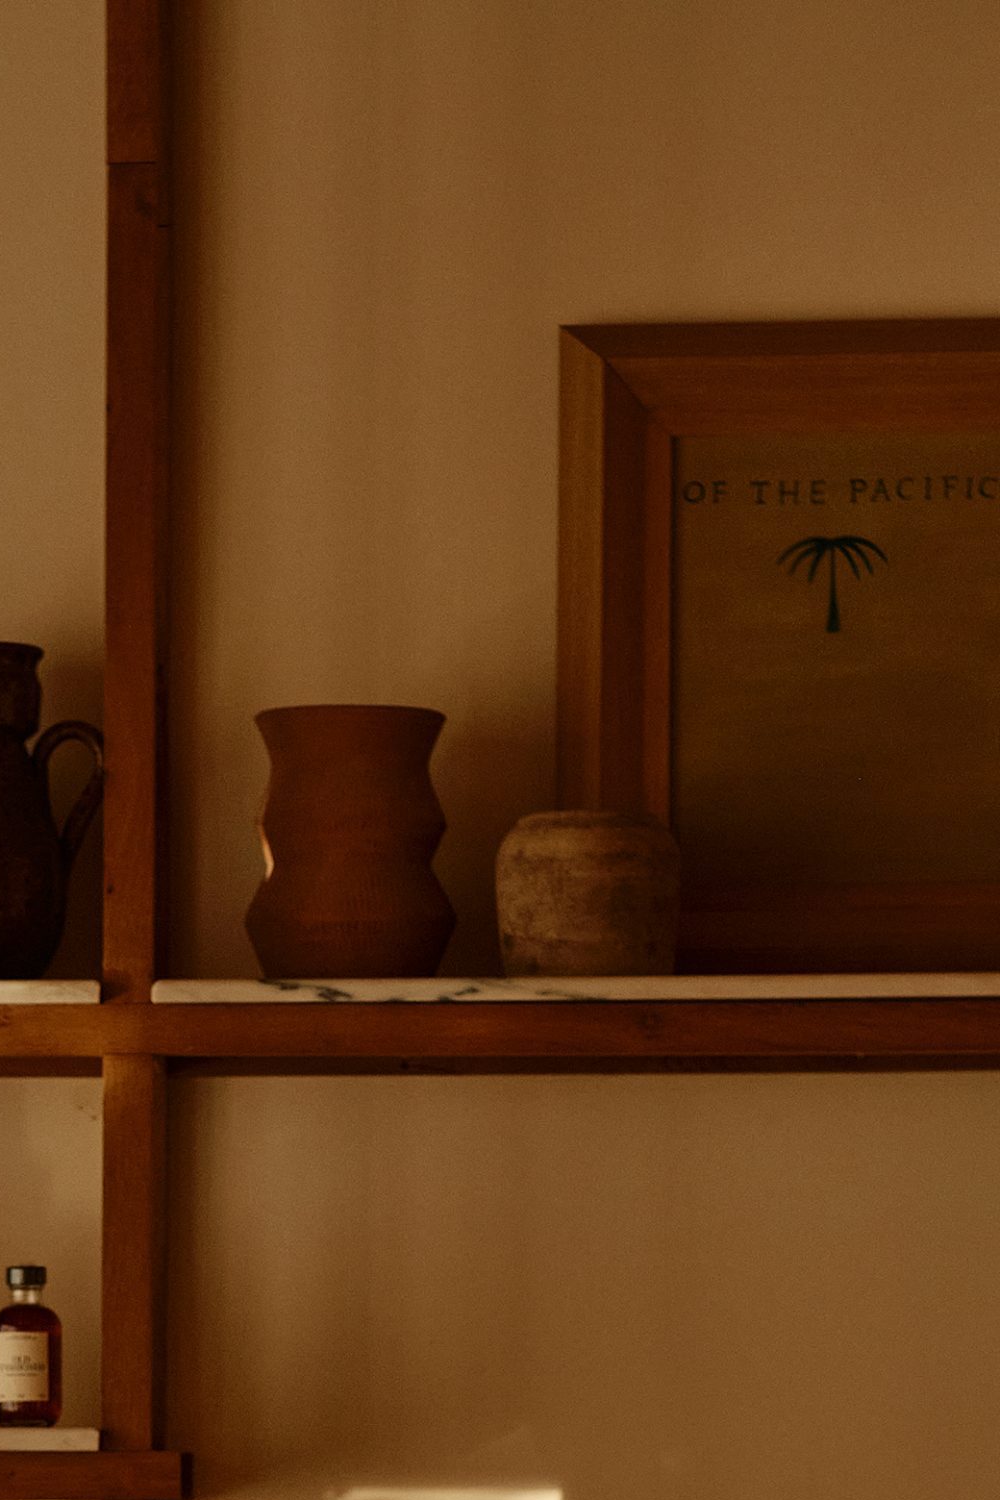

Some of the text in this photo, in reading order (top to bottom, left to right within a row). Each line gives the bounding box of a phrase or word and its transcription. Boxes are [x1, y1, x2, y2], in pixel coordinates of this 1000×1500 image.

[682, 477, 1000, 504] OF THE PACIFIC
